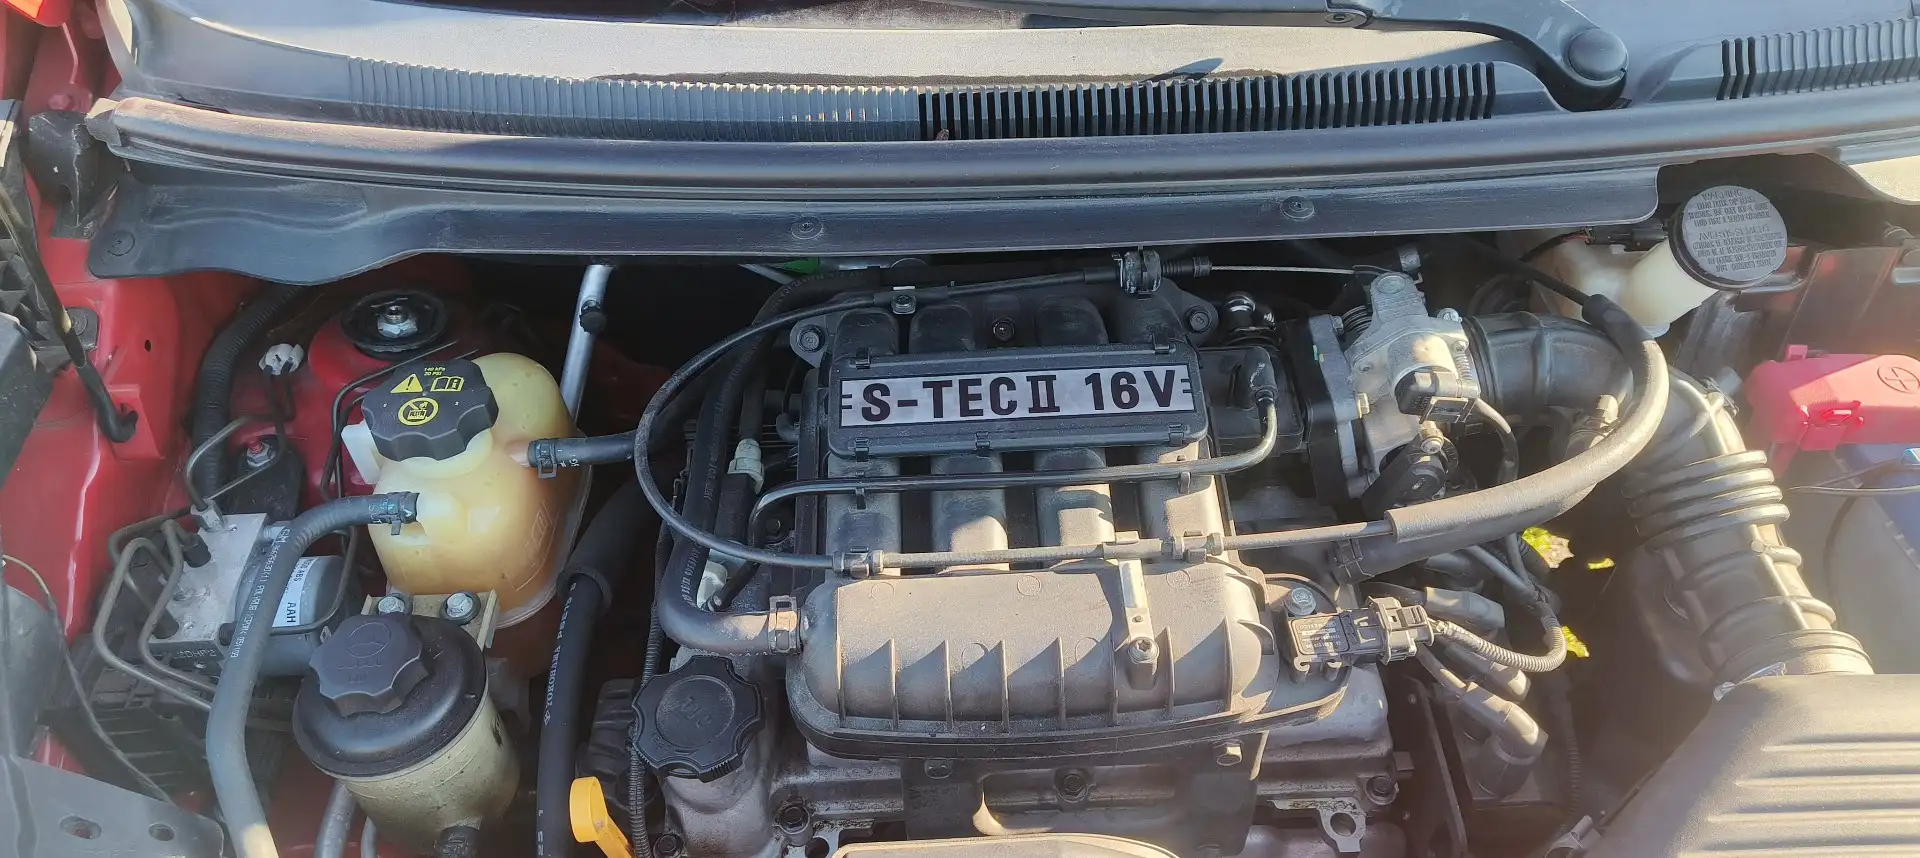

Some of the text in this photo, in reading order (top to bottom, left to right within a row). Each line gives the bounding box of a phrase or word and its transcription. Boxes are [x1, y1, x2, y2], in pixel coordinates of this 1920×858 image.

[1084, 368, 1177, 412] 16V
[286, 602, 298, 623] AAH
[545, 644, 562, 709] YOKOHAMA
